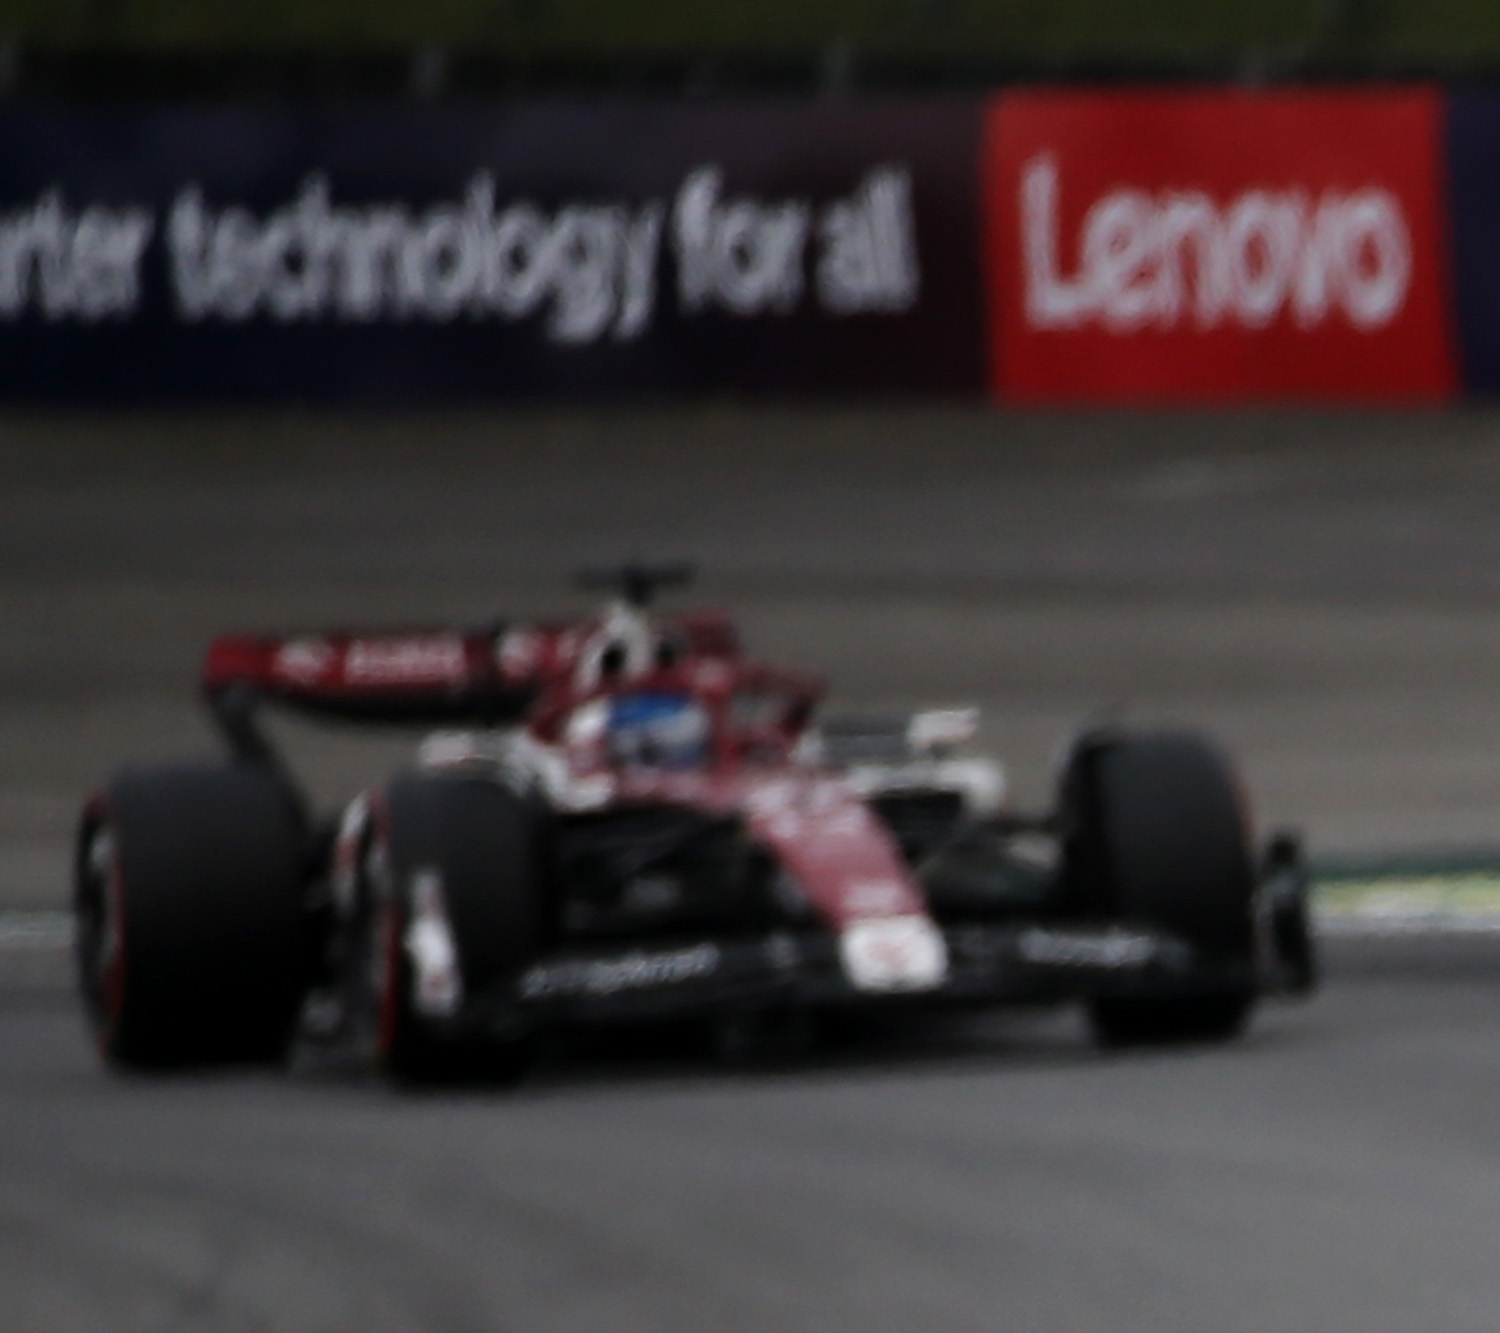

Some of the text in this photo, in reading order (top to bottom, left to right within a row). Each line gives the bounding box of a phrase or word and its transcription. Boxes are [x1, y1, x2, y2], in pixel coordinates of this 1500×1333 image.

[170, 168, 660, 342] technology
[675, 165, 803, 315] for
[818, 163, 918, 315] all
[1018, 152, 1410, 330] Lenovo
